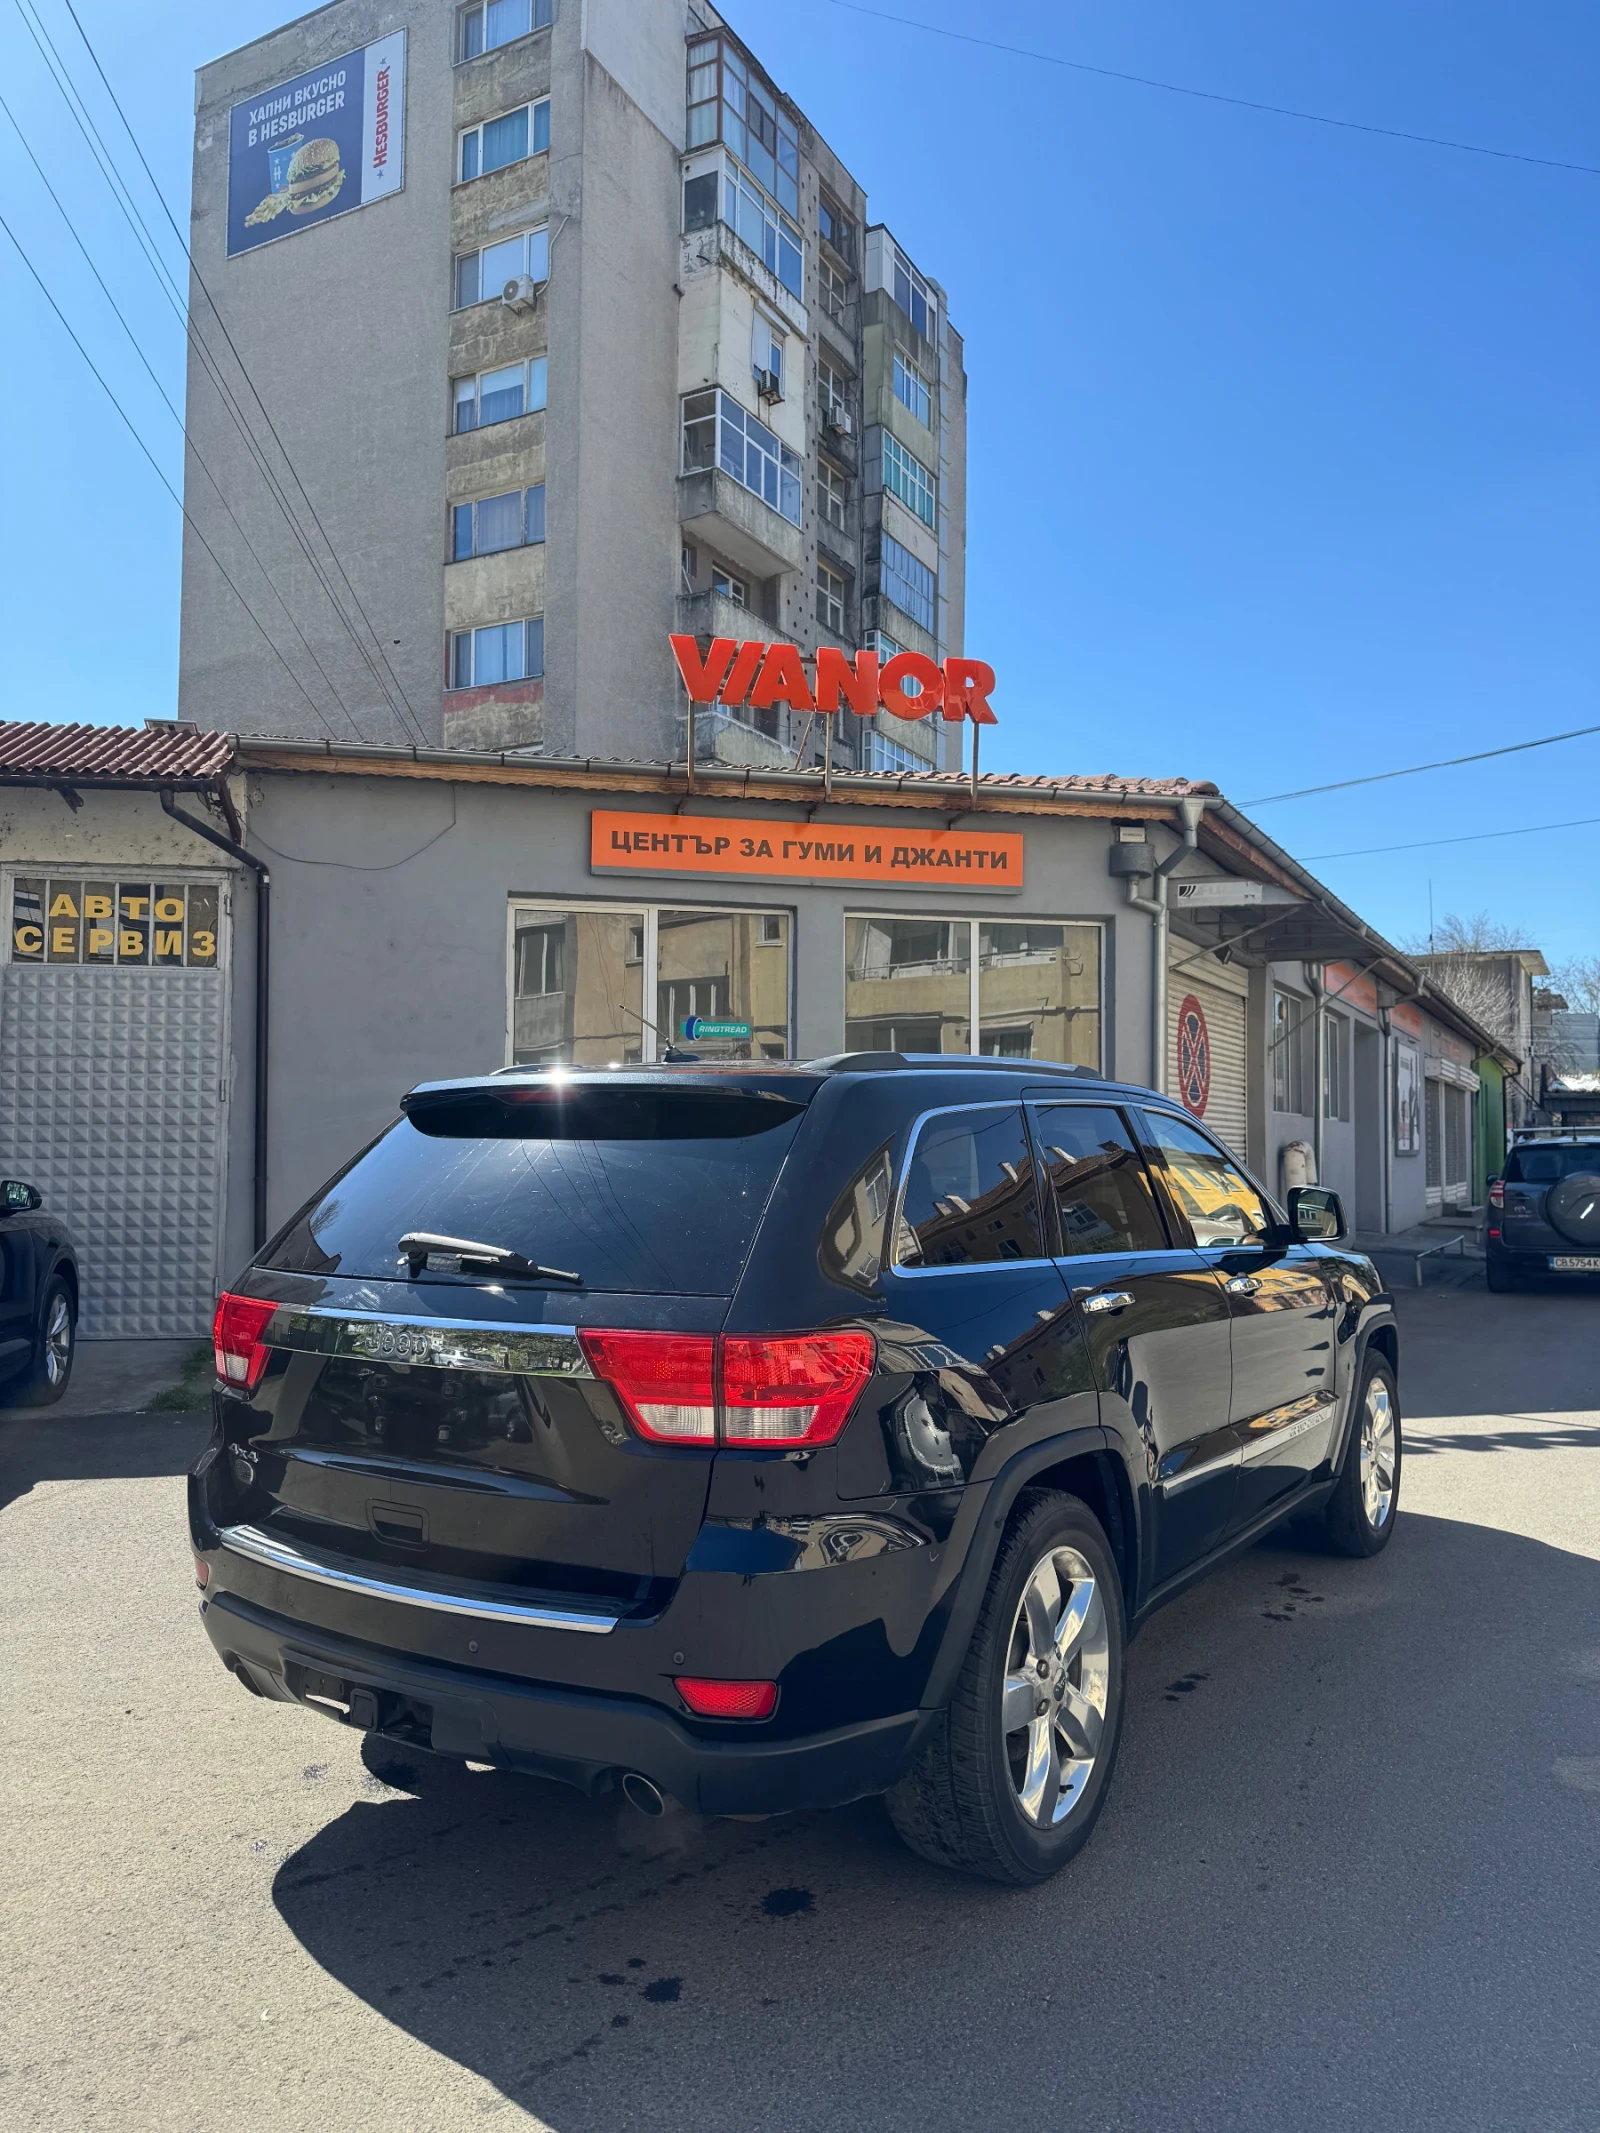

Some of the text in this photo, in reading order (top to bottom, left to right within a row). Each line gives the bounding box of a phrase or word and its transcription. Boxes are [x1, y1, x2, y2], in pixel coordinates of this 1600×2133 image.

[249, 70, 346, 126] ХАПНИ ВКУСНО
[373, 66, 390, 168] HESBURGER
[248, 91, 345, 147] В HESBURGER
[668, 633, 999, 725] VIANOR
[611, 830, 1008, 870] ЦЕНТЪР ЗА ГУМИ И ДЖАНТИ
[49, 894, 185, 922] АВТО
[15, 926, 216, 957] СЕРВИЗ
[699, 1025, 747, 1033] RINGTREAD
[364, 1330, 429, 1363] Jeep
